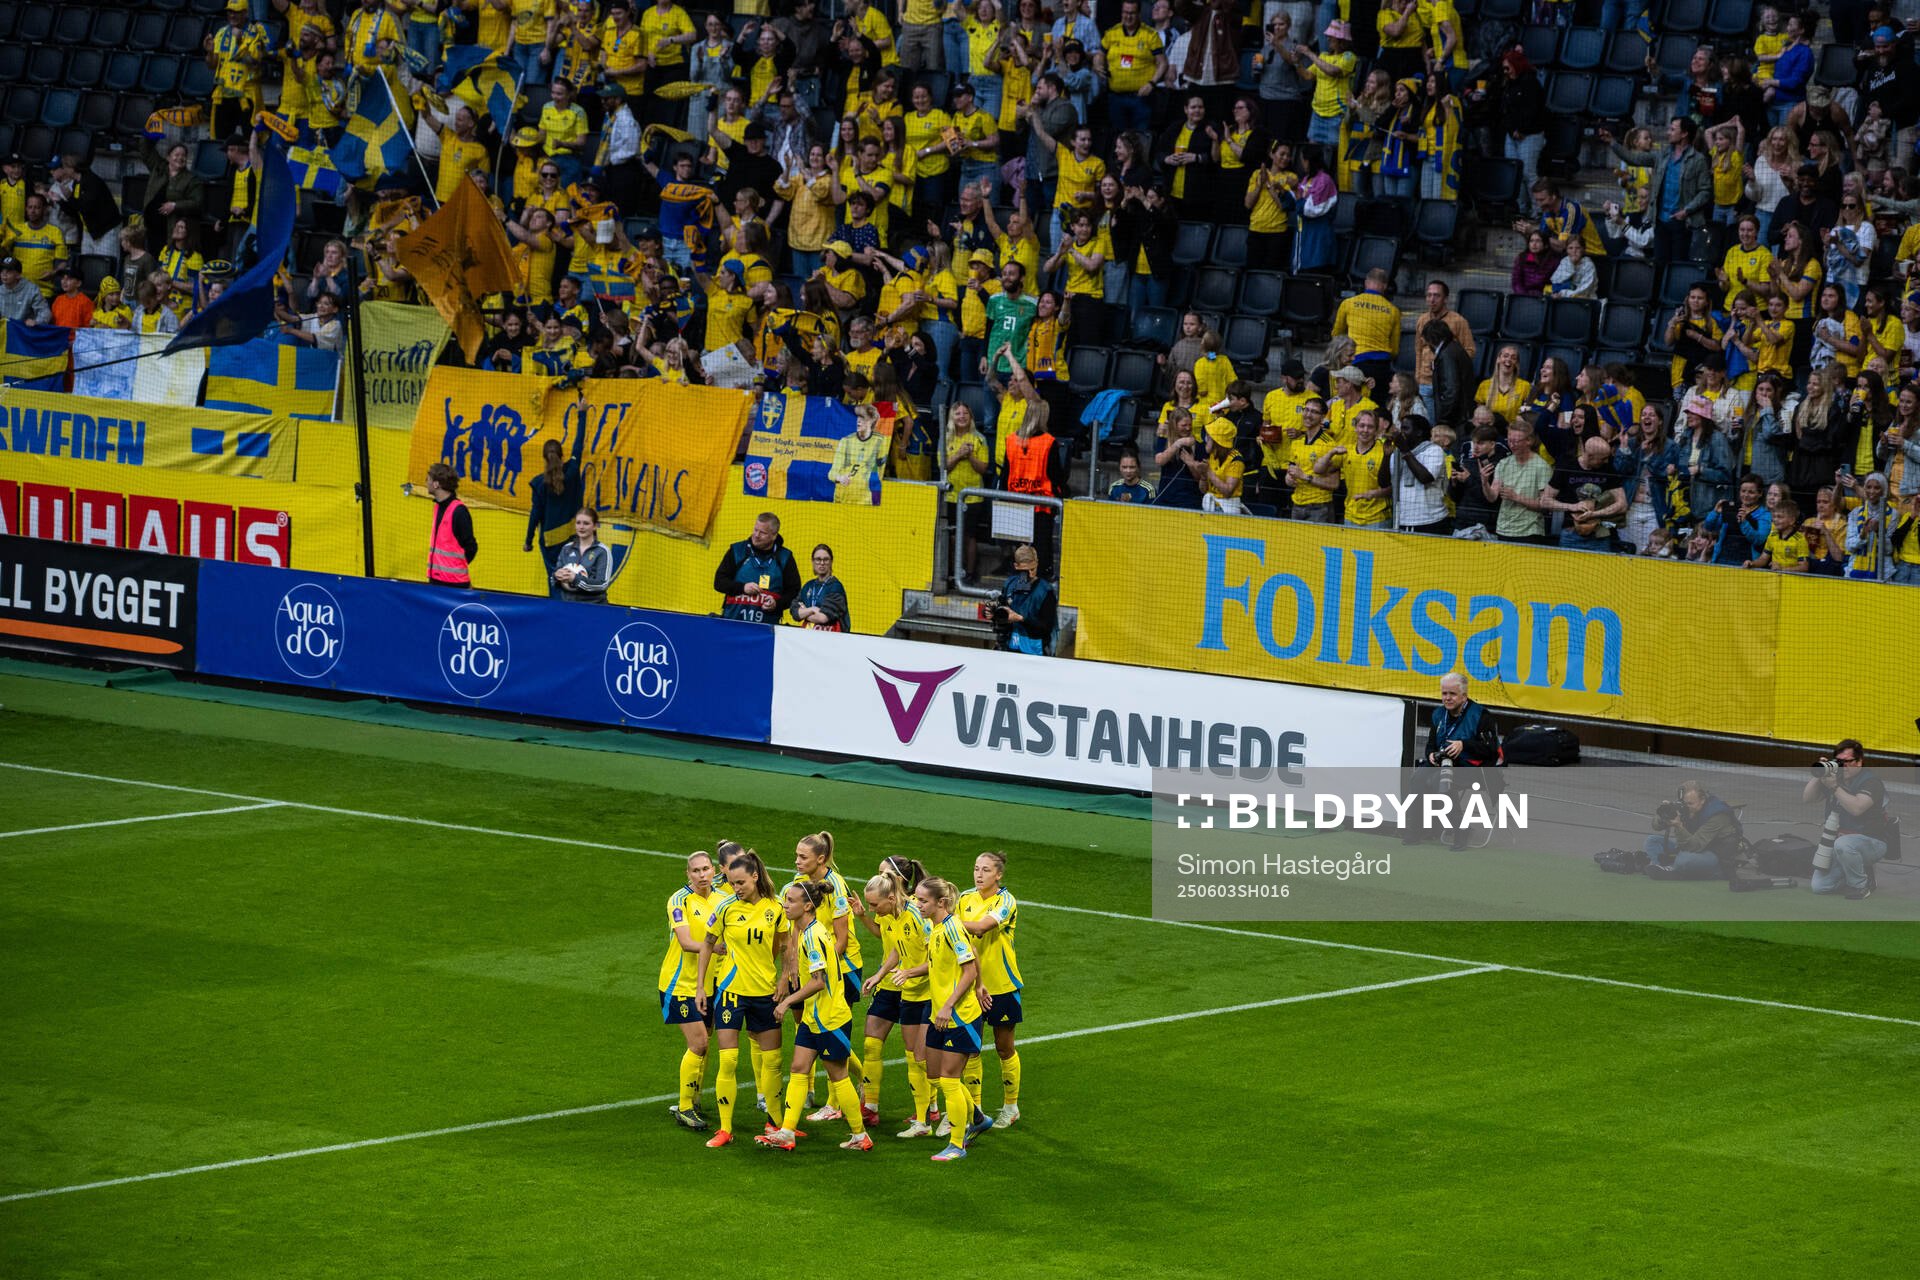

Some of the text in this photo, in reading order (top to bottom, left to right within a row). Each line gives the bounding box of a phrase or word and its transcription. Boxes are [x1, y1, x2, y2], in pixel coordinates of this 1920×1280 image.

[1003, 315, 1016, 331] 21
[44, 567, 185, 629] BYGGET
[278, 594, 335, 631] Aqua
[740, 608, 764, 622] 119
[1196, 533, 1624, 696] Folksam
[442, 614, 500, 651] Aqua
[608, 633, 669, 671] Aqua
[952, 682, 1308, 787] VÄSTANHEDE
[746, 927, 763, 944] 14
[722, 991, 738, 1008] 14
